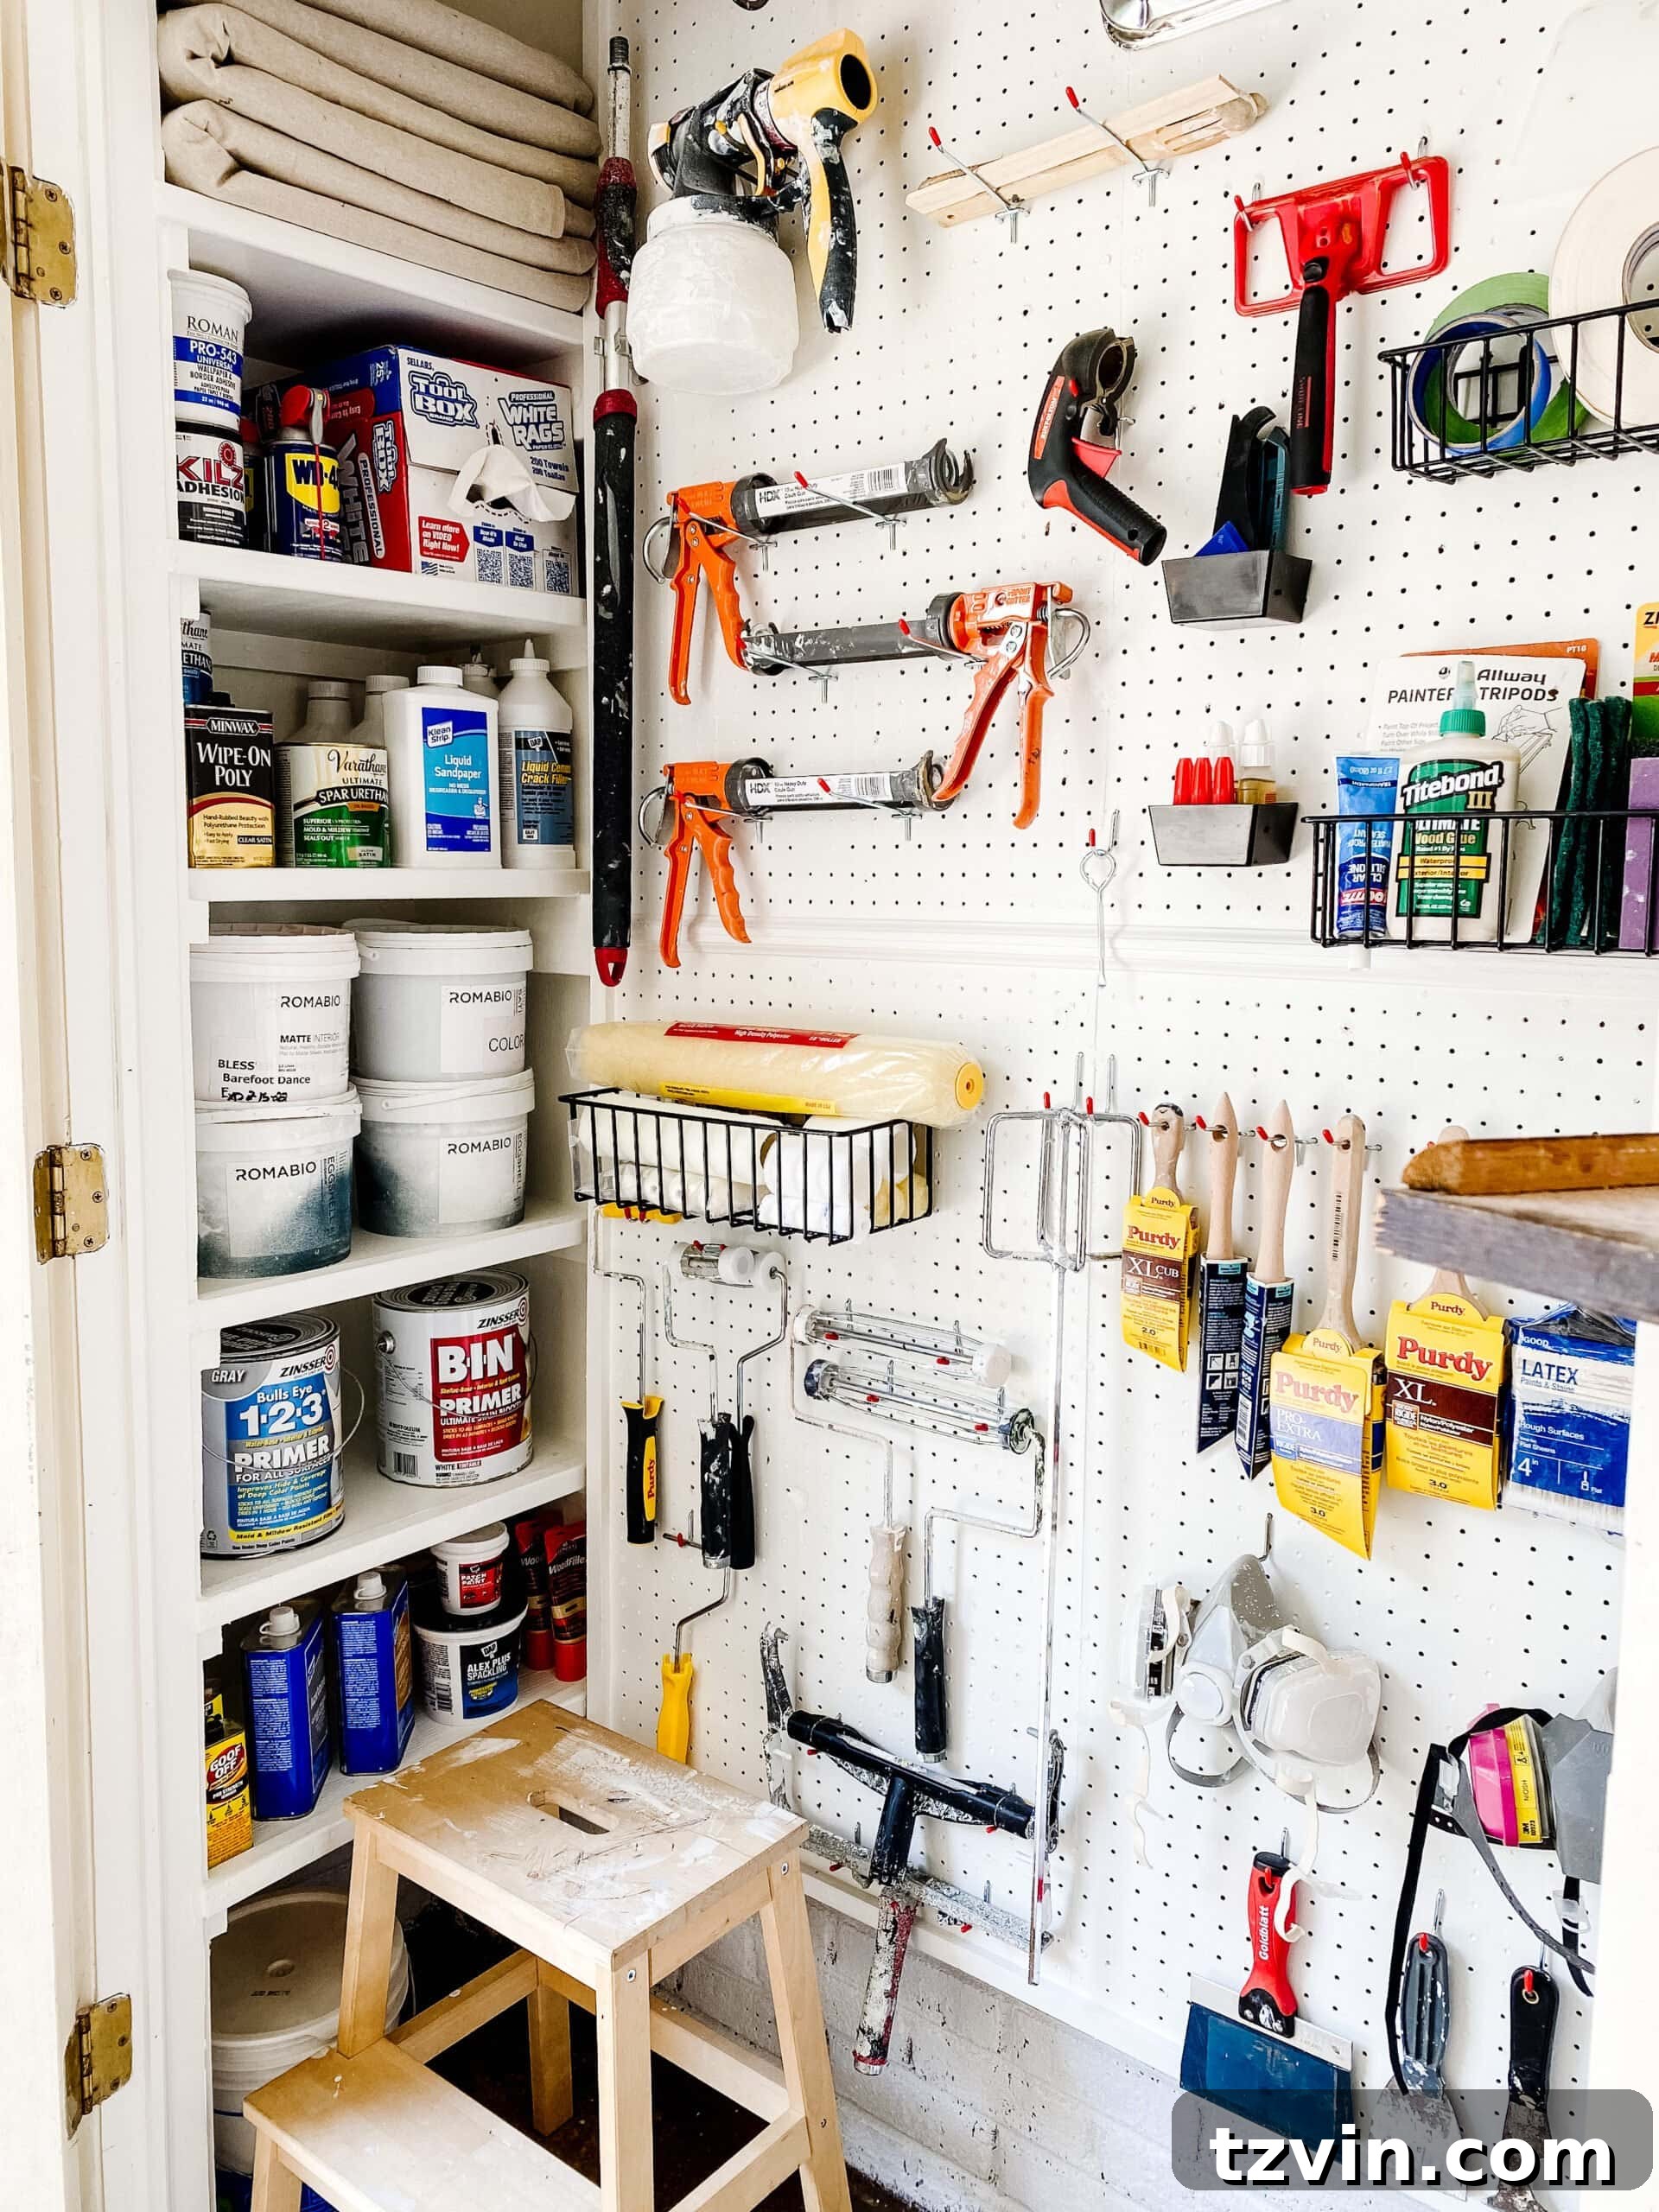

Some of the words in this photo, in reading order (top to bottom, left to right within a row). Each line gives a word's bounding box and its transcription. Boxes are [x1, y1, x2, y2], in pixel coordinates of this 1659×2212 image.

[188, 315, 238, 342] ROMAN
[189, 340, 238, 365] PRO-543
[196, 354, 233, 372] UNIVERSAL
[411, 376, 468, 402] TOOL
[511, 391, 554, 402] PROFESSIONAL
[415, 393, 474, 422] BOX
[498, 397, 557, 426] WHITE
[513, 421, 563, 451] RAGS
[176, 454, 244, 491] KILZ
[543, 459, 569, 473] Towels
[292, 459, 339, 491] WD-4
[177, 480, 245, 505] ADHESION
[760, 491, 779, 504] HDX
[360, 458, 384, 556] PROFESSIONAL
[422, 519, 442, 532] Learn
[432, 530, 452, 541] VIDEO
[423, 537, 441, 550] Right
[442, 542, 460, 553] Now!
[1477, 669, 1547, 685] Allway
[1479, 688, 1559, 702] TRIPODS
[211, 719, 257, 734] MINWAX
[429, 726, 451, 736] Klean
[196, 741, 271, 768] WIPE-ON
[444, 754, 473, 768] Liquid
[435, 766, 482, 781] Sandpaper
[521, 760, 550, 773] Liquid
[214, 765, 253, 787] POLY
[342, 777, 383, 786] ULTIMATE
[521, 772, 550, 785] Crack
[750, 782, 771, 794] HDX
[1402, 764, 1500, 807] Titebond
[319, 789, 350, 804] SPAR
[351, 788, 387, 802] URETHA
[1466, 791, 1494, 810] III
[1353, 829, 1386, 839] SEAANT
[1445, 831, 1477, 844] Gue
[1348, 863, 1386, 874] SILIONE
[1351, 873, 1382, 883] CLAR
[280, 995, 340, 1008] ROMABIO
[449, 990, 512, 1004] ROMABIO
[280, 1034, 311, 1044] MATTE
[488, 1033, 524, 1052] COLOR
[747, 1030, 767, 1039] Density
[218, 1059, 256, 1071] BLESS
[223, 1072, 274, 1085] Barefoot
[277, 1076, 311, 1085] Dance
[448, 1137, 512, 1155] ROMABIO
[235, 1160, 317, 1181] ROMABIO
[1151, 1197, 1175, 1208] Purdy
[1127, 1225, 1180, 1250] Purdy
[1127, 1255, 1160, 1280] XL
[1154, 1264, 1179, 1278] CUB
[1430, 1300, 1466, 1316] Purdy
[477, 1308, 519, 1330] ZINSSER
[1141, 1325, 1157, 1337] 2.0
[1313, 1337, 1343, 1354] Purdy
[1396, 1336, 1493, 1381] Purdy
[279, 1356, 326, 1378] ZINSSER
[1522, 1358, 1580, 1386] LATEX
[211, 1368, 246, 1383] GRAY
[1521, 1377, 1542, 1388] Paints
[257, 1388, 289, 1404] Bulls
[292, 1384, 313, 1399] Eye
[439, 1382, 522, 1417] PRIMER
[1274, 1370, 1360, 1414] Purdy
[440, 1416, 476, 1426] ULTIMATE
[1276, 1421, 1322, 1441] EXTRA
[1519, 1421, 1547, 1434] Rough
[1547, 1426, 1585, 1440] Surfaces
[234, 1434, 330, 1473] PRIMER
[1517, 1457, 1533, 1478] 4
[1531, 1458, 1539, 1466] in
[236, 1473, 260, 1483] FOR
[264, 1471, 284, 1480] ALL
[646, 1458, 656, 1500] Purdy
[1428, 1478, 1448, 1490] 3.0
[237, 1483, 272, 1493] Improves
[247, 1491, 267, 1499] Deep
[270, 1487, 288, 1496] Color
[1310, 1506, 1326, 1517] 3.0
[265, 1528, 292, 1536] Mildew
[549, 1554, 588, 1575] WoodFille
[483, 1643, 497, 1656] DAP
[467, 1660, 490, 1673] ALEX
[492, 1652, 512, 1668] PLUS
[467, 1664, 507, 1681] SPACKLING
[210, 1743, 242, 1771] GOOF
[214, 1757, 237, 1779] OFF
[1522, 1822, 1529, 1834] 3M
[1258, 1904, 1270, 1961] Goldblatt
